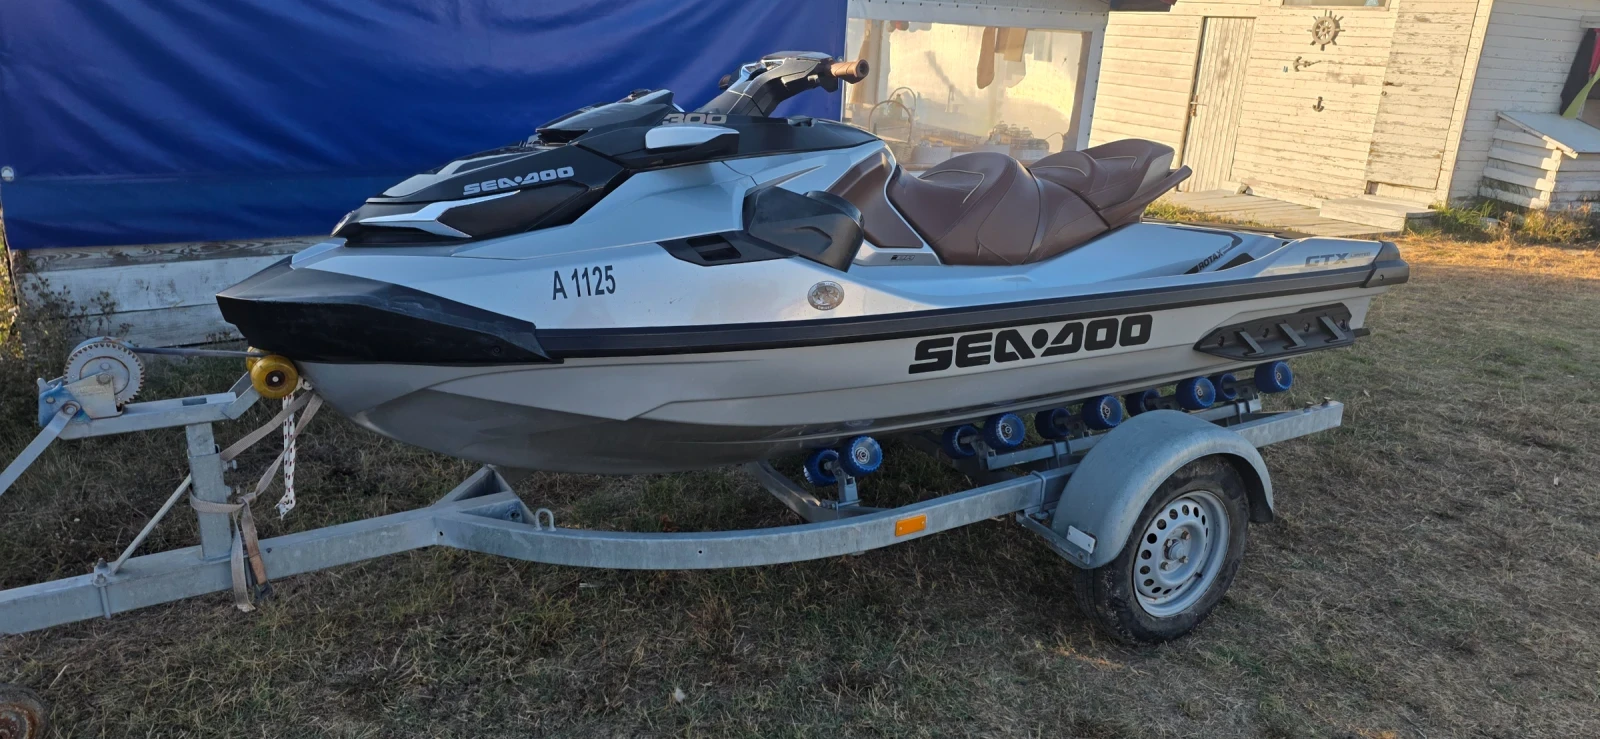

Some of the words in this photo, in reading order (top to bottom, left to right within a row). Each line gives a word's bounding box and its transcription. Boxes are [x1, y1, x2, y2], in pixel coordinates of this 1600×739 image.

[662, 113, 728, 126] 300
[1198, 249, 1224, 271] ROTAX
[1305, 252, 1349, 267] GTX
[552, 270, 568, 300] A
[571, 265, 616, 297] 1125
